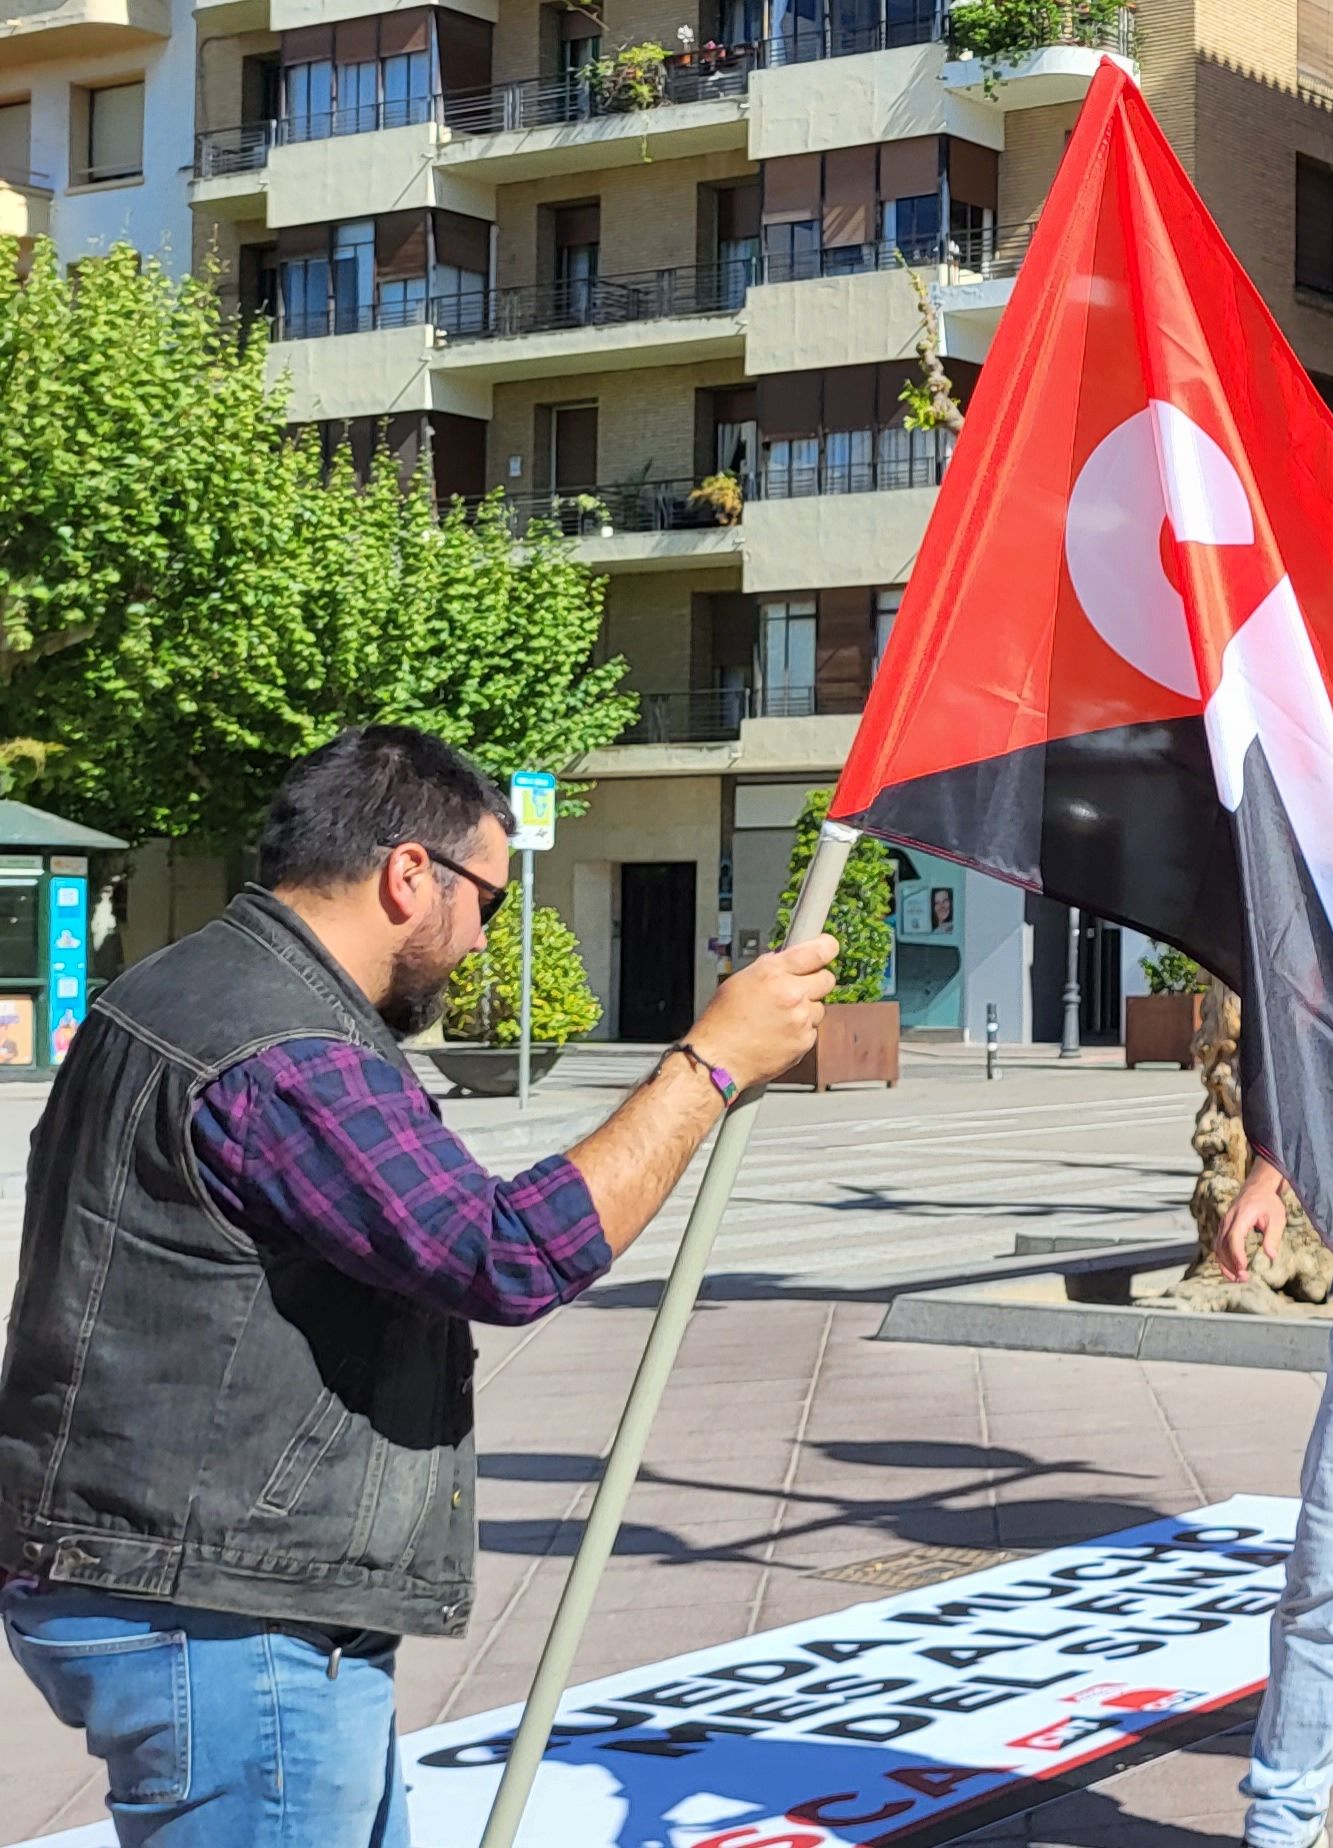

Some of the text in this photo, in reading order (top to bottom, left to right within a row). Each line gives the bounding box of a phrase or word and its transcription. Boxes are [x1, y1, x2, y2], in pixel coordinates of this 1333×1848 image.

[417, 1527, 1265, 1768] QUEDA MUCHO
[596, 1672, 918, 1757] MES
[912, 1624, 1097, 1670] AL
[799, 1669, 1095, 1744] DEL
